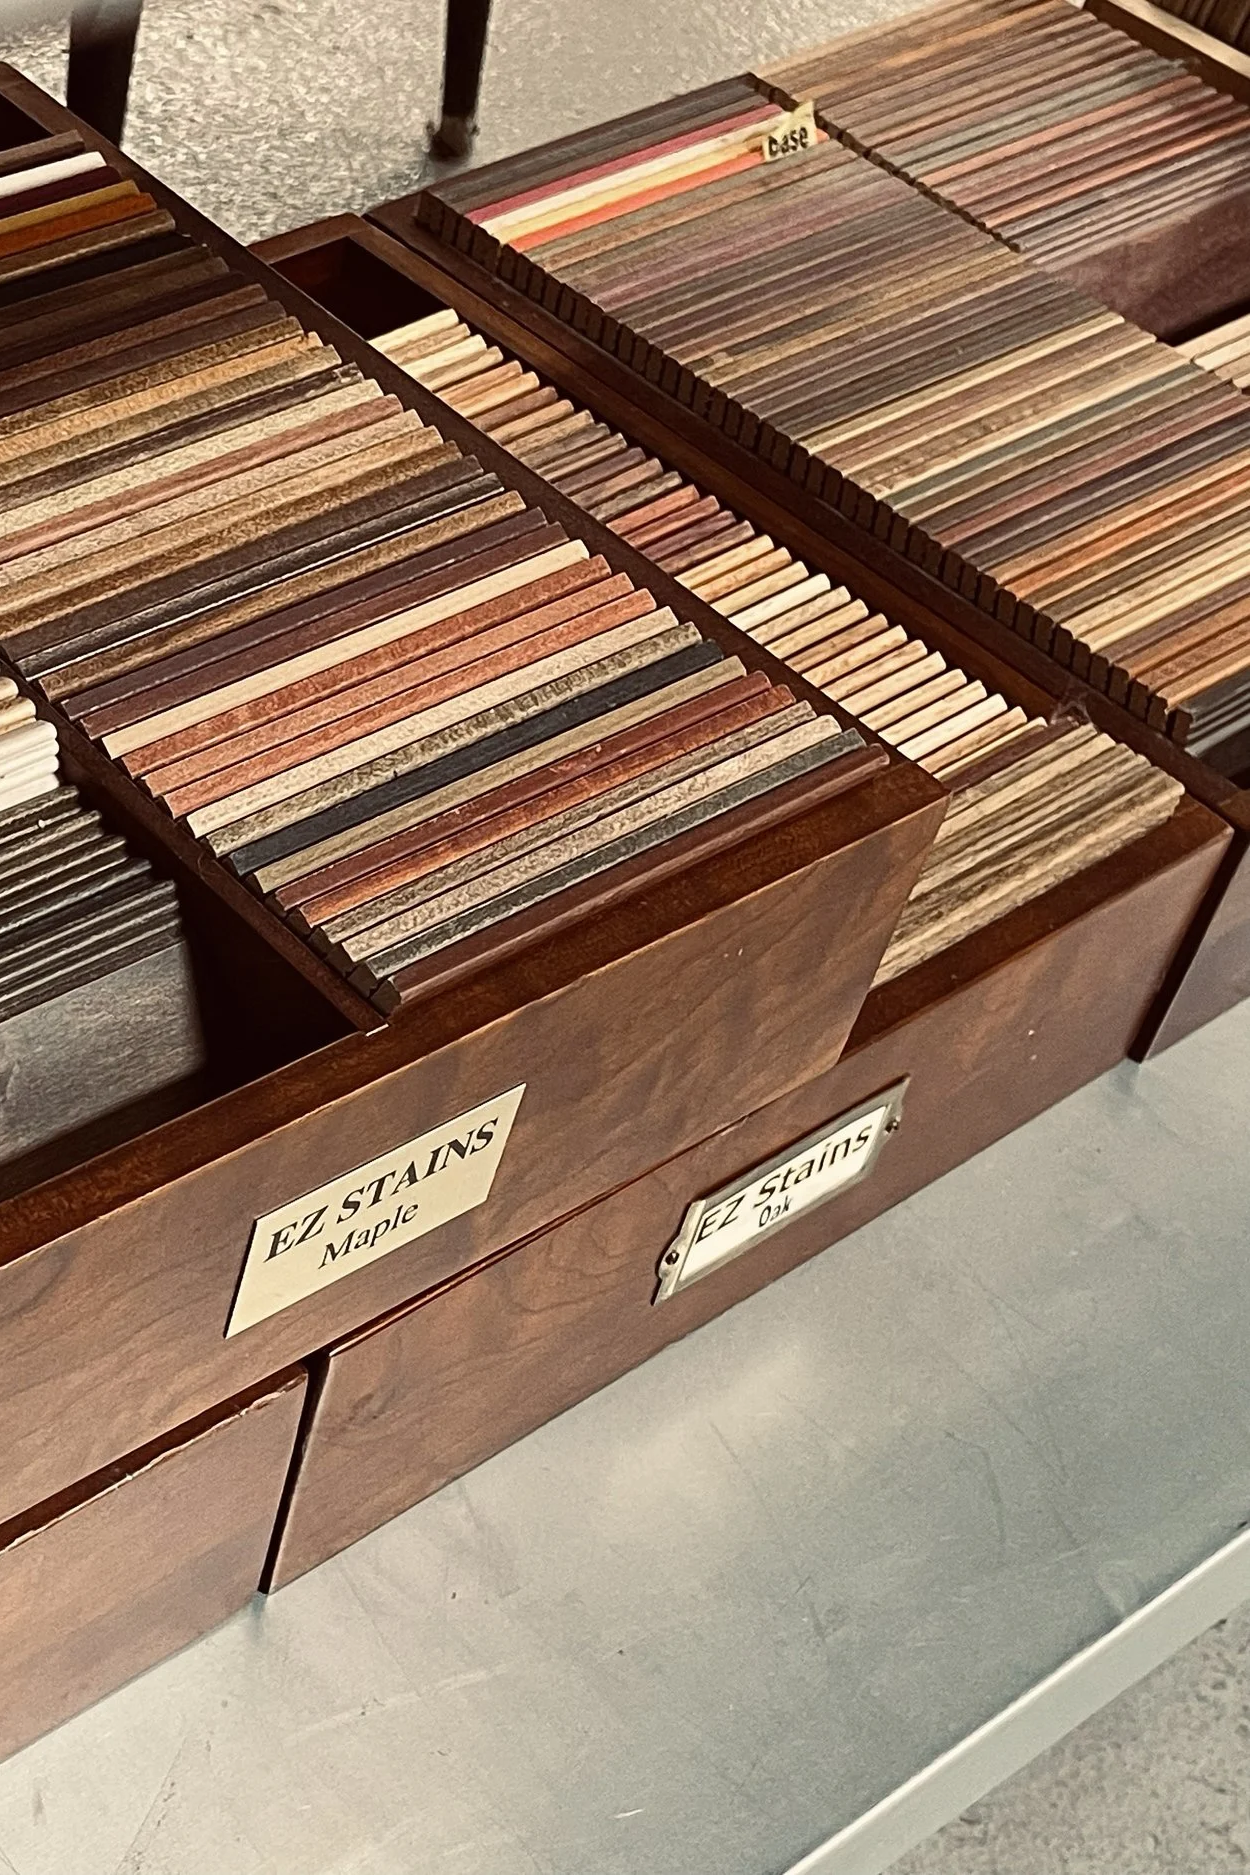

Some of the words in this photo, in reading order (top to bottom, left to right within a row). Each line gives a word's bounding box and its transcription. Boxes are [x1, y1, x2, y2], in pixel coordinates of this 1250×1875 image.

[263, 1205, 329, 1263] EZ
[336, 1117, 499, 1225] STAINS
[695, 1194, 746, 1244] EZ
[753, 1125, 873, 1209] Stains
[758, 1195, 792, 1228] Oak
[318, 1202, 419, 1270] Maple
